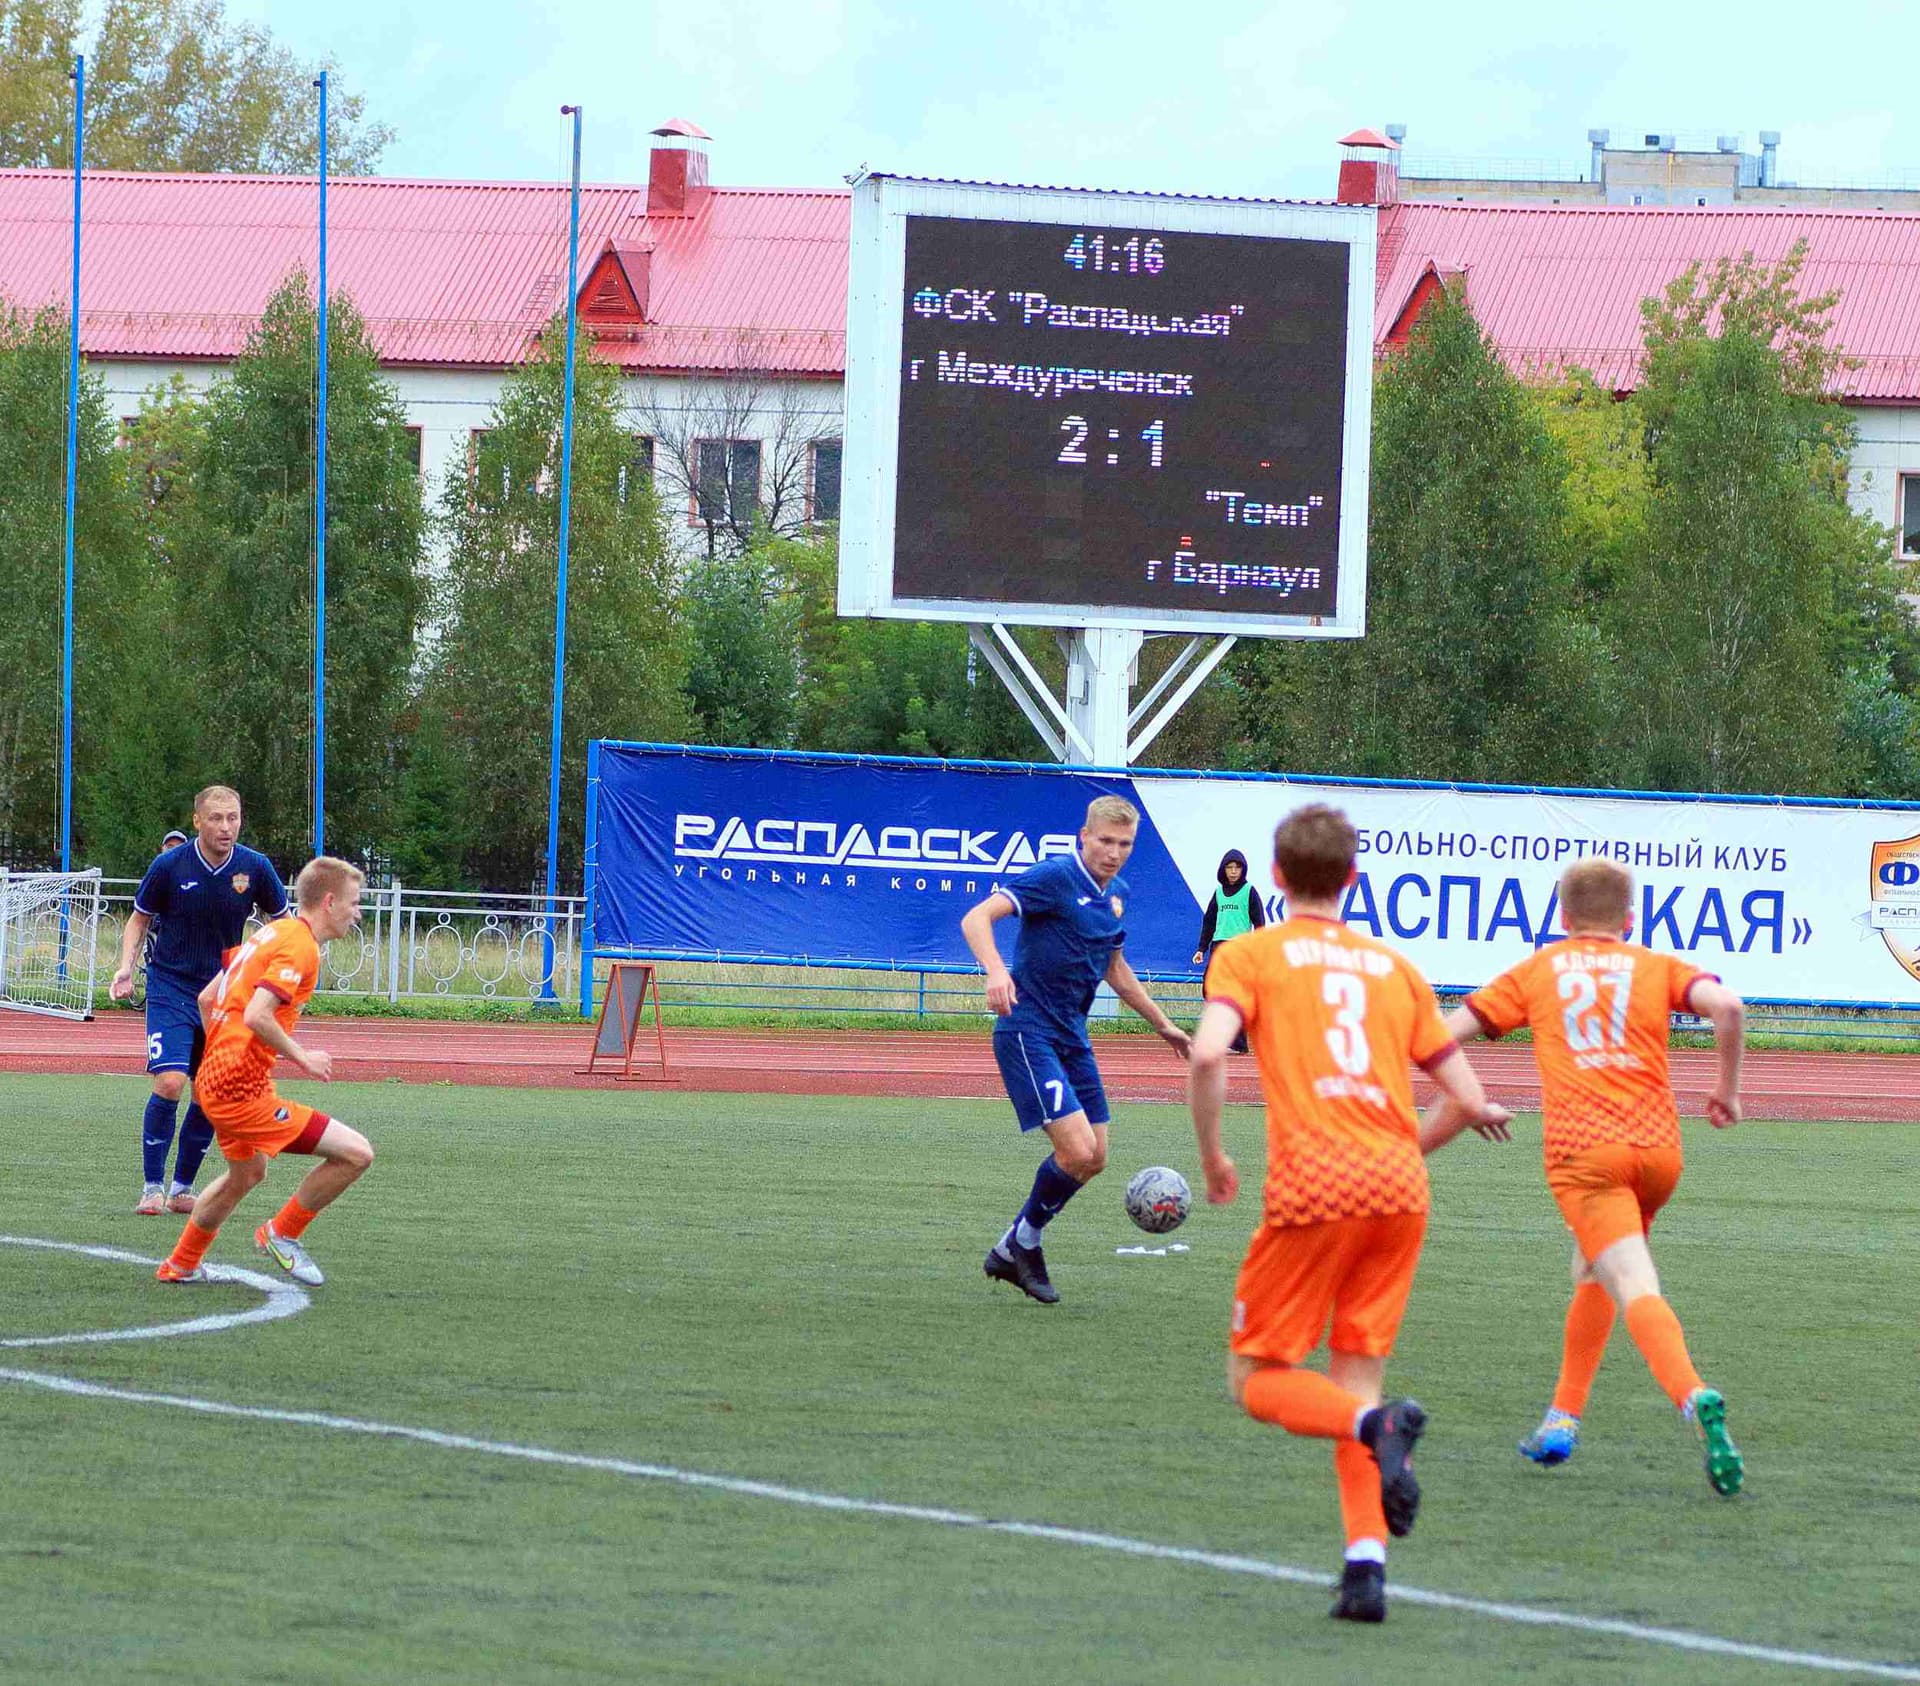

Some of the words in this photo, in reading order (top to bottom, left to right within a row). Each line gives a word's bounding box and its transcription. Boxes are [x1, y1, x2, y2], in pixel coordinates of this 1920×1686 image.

[1064, 233, 1165, 274] 41:16
[912, 286, 997, 322] ФСК
[911, 359, 925, 381] г
[937, 350, 1194, 398] Междуреченск
[1205, 490, 1324, 526] "Темп"
[1147, 560, 1162, 581] г
[1173, 551, 1321, 597] Барнаул
[674, 813, 1077, 874] РАСПАДСКАЯ
[1356, 828, 1702, 869] БОЛЬНО-СПОРТИВНЫЙ
[1714, 845, 1787, 872] КЛУБ
[674, 865, 856, 887] УГОЛЬНАЯ
[890, 877, 1001, 894] КОМПА
[1322, 971, 1371, 1076] 3
[1557, 970, 1635, 1051] 27
[1045, 1079, 1064, 1112] 7
